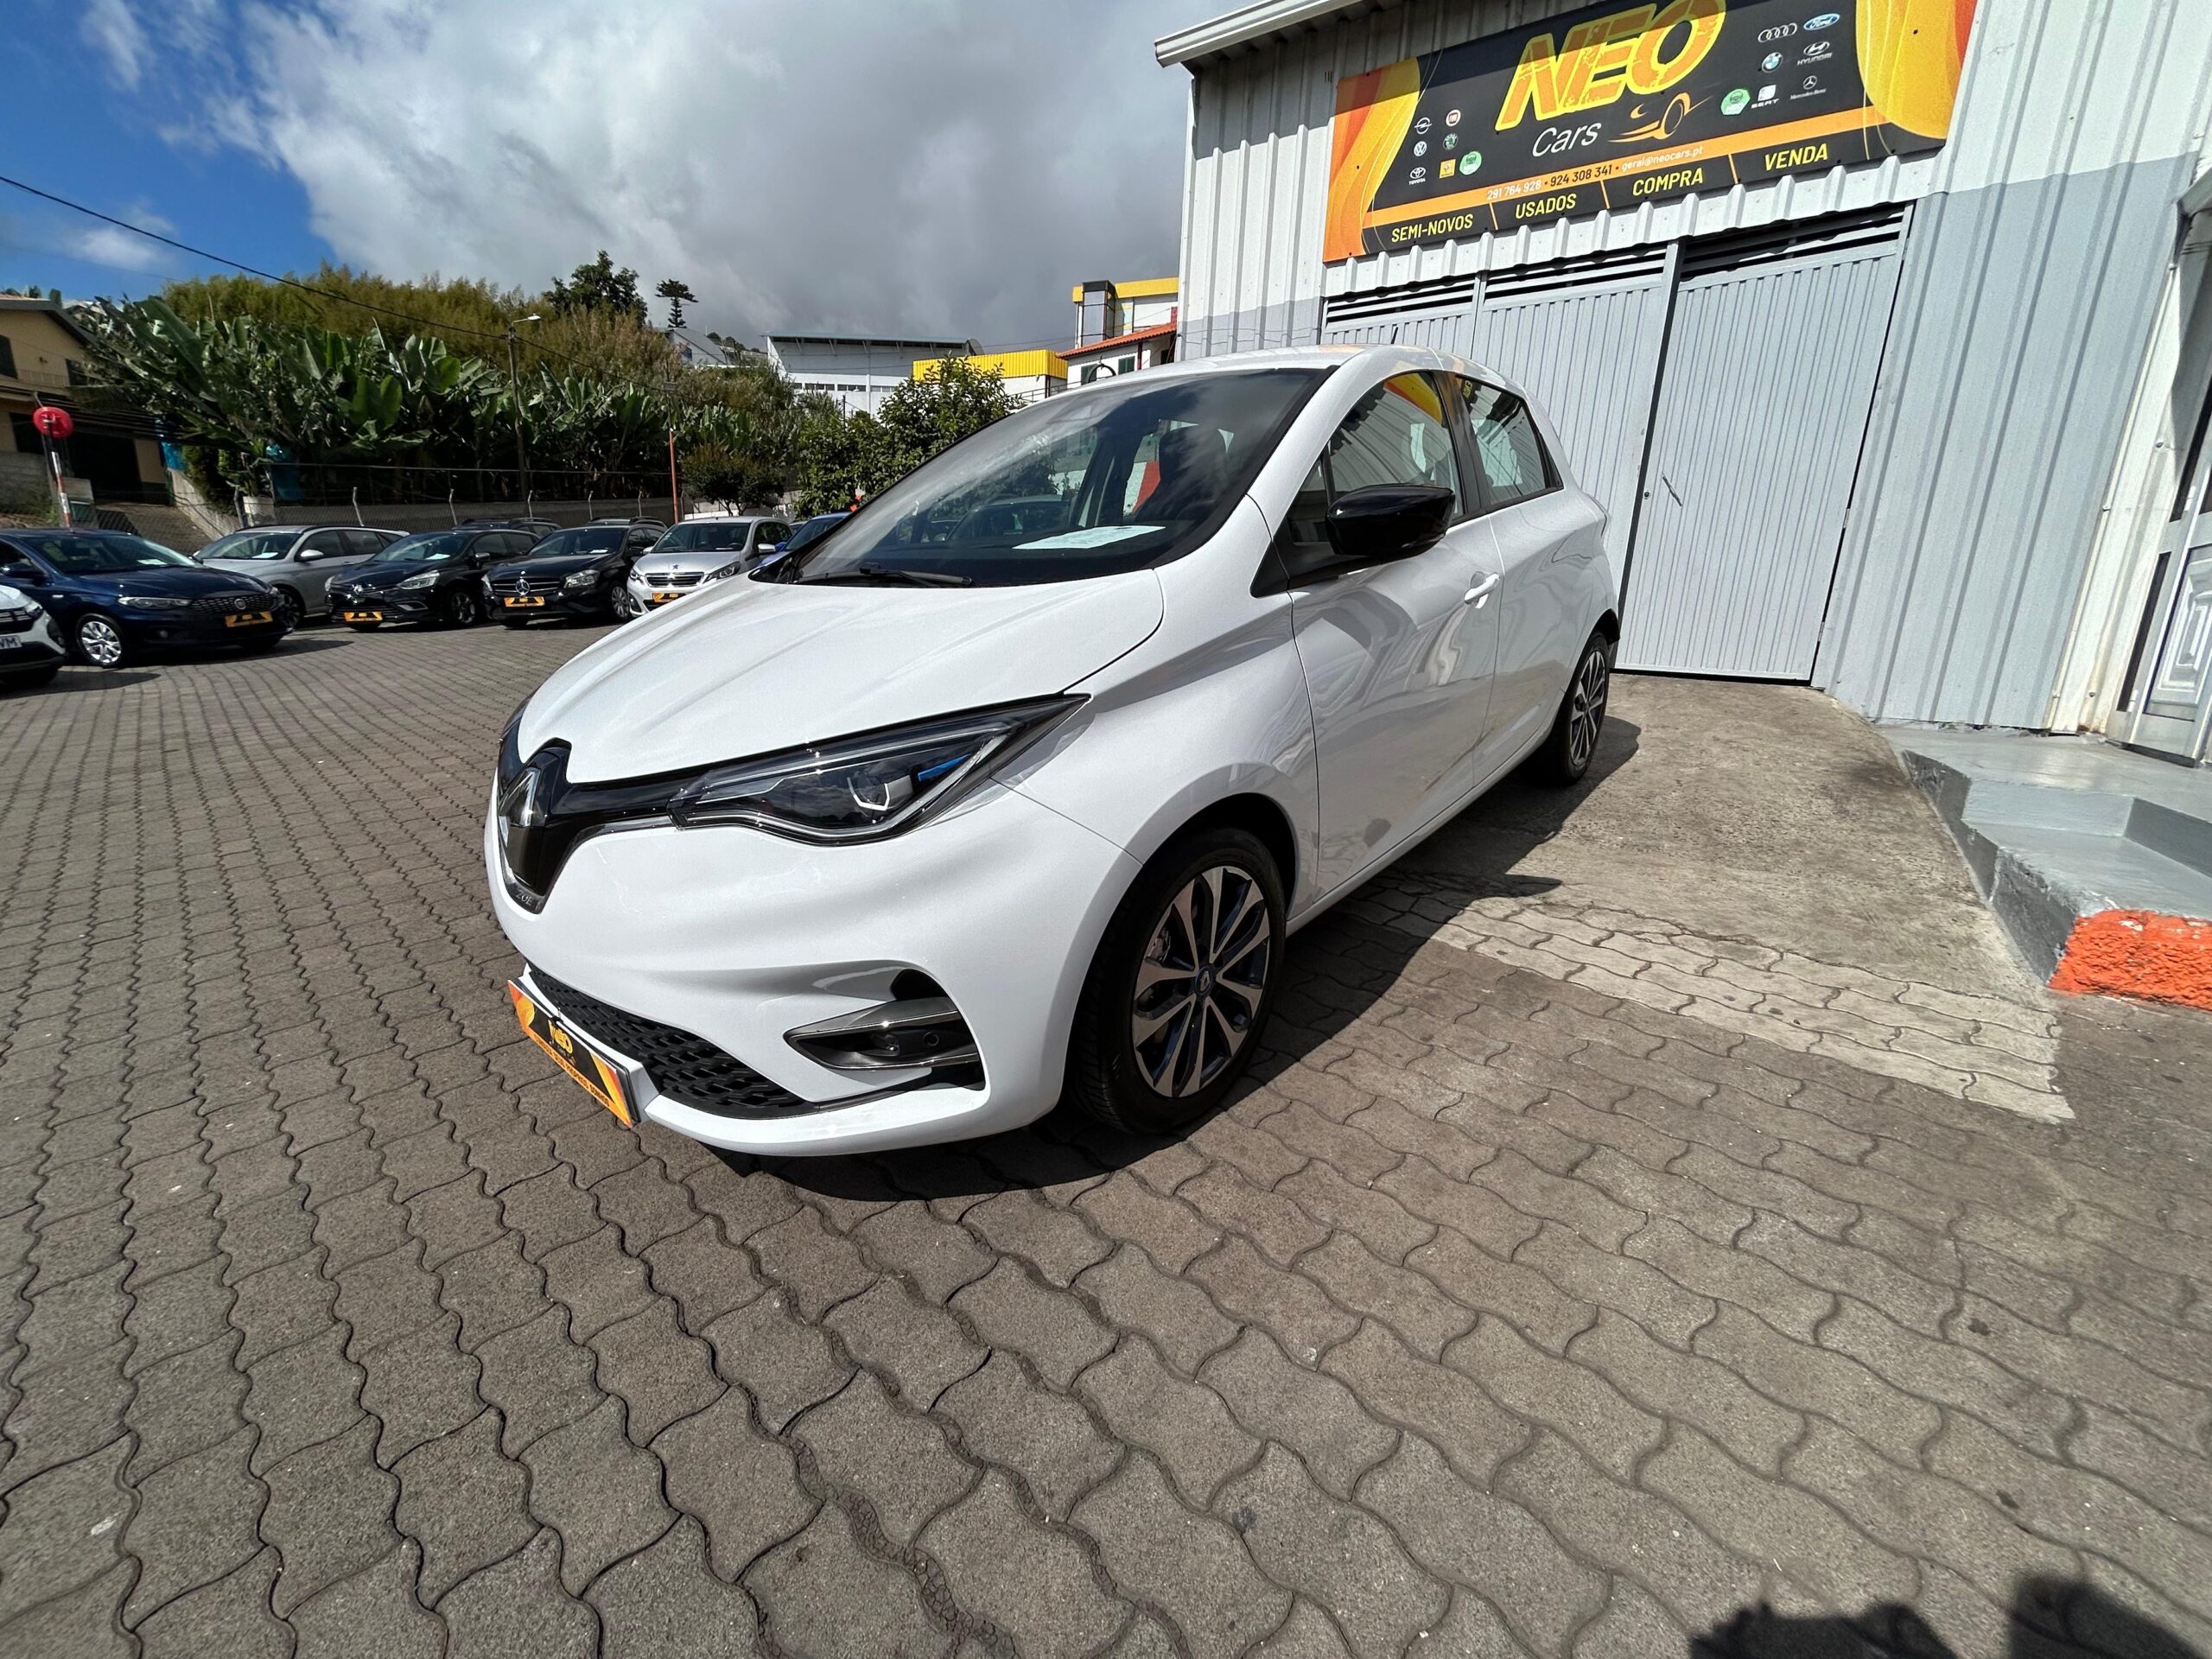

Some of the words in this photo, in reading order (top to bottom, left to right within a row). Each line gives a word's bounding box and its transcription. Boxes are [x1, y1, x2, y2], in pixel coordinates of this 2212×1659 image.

[1495, 0, 1726, 130] NEO
[1797, 53, 1833, 66] HYUNDAI
[1751, 98, 1780, 109] SEAT
[1532, 123, 1602, 157] Cars
[1764, 143, 1828, 171] VENDA
[1486, 188, 1502, 200] 291
[1504, 186, 1522, 196] 764
[1523, 180, 1542, 192] 928
[1549, 174, 1570, 187] 924
[1572, 168, 1592, 182] 308
[1594, 164, 1612, 178] 341
[1622, 145, 1704, 172] geral@neocars.pt
[1632, 168, 1704, 196] COMPRA
[1515, 193, 1577, 219] USADOS
[1391, 213, 1474, 243] SEMI-NOVOS
[515, 889, 533, 906] ZOE
